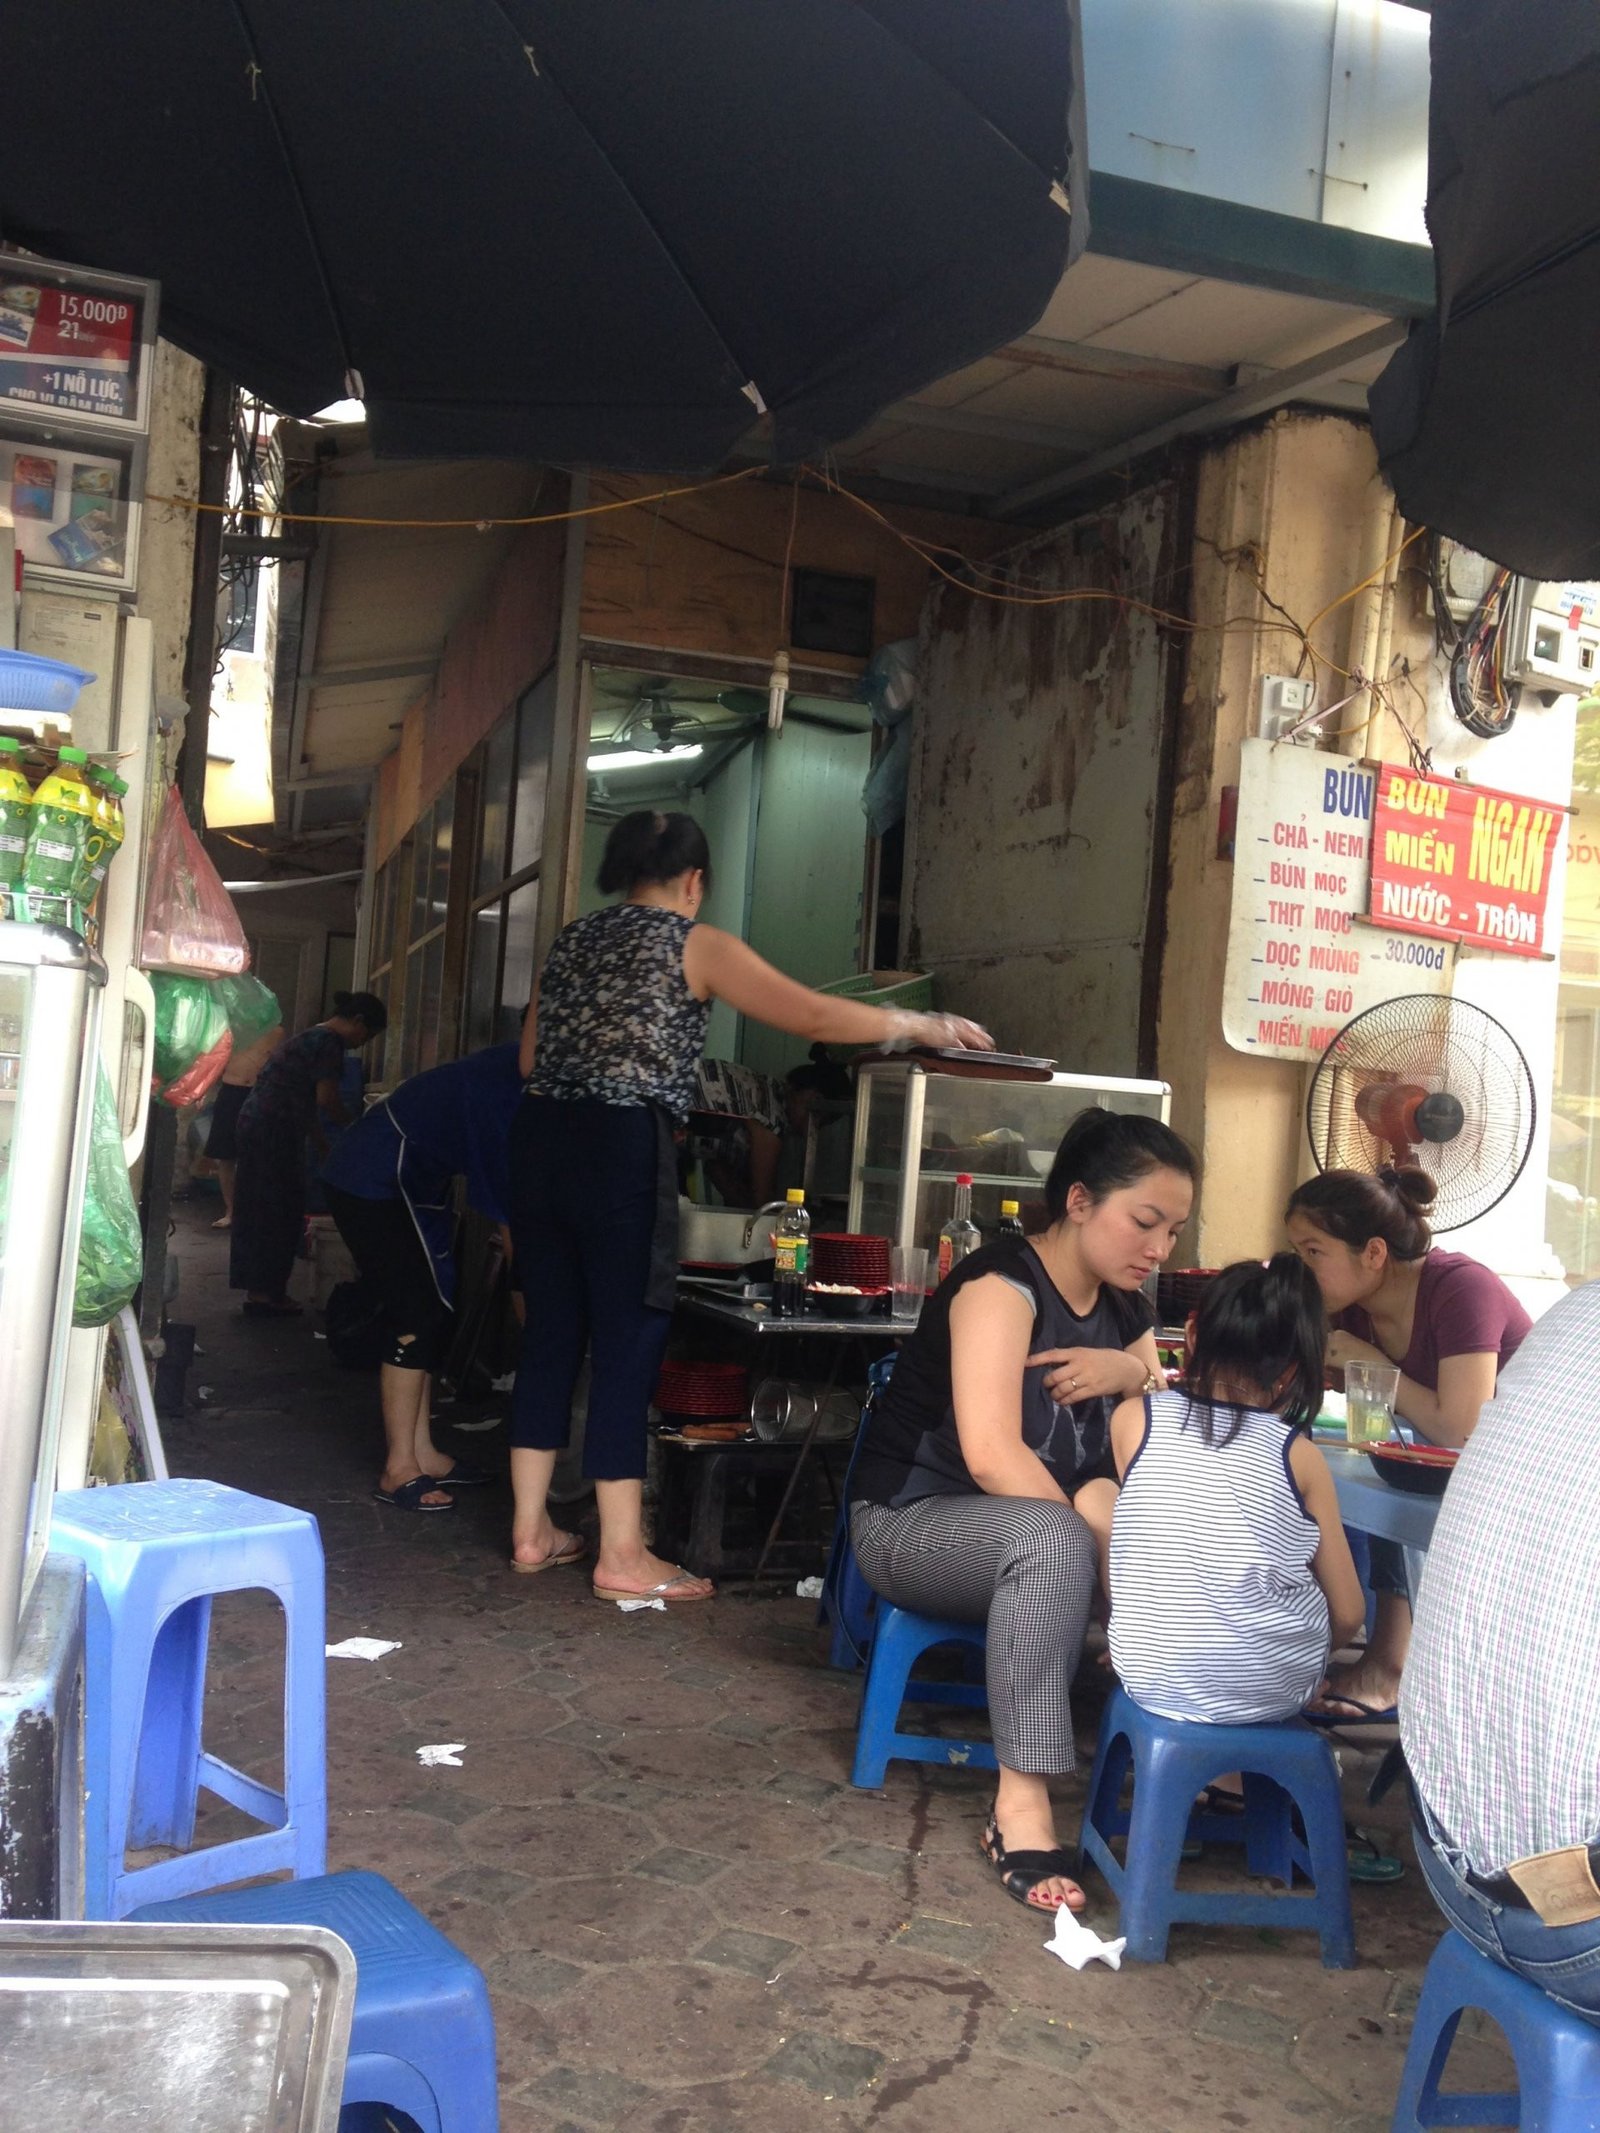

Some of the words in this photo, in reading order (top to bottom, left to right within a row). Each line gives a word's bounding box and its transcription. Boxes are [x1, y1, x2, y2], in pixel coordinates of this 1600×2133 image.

[57, 320, 80, 339] 21
[63, 370, 87, 395] NỖ
[1323, 762, 1372, 820] BÚN
[1273, 813, 1308, 849] CHẢ
[1324, 830, 1363, 859] NEM
[1385, 828, 1455, 877] MIẾN
[1468, 796, 1553, 895] NGAN
[1270, 857, 1306, 889] BÚN
[1314, 872, 1347, 897] MỌC
[1268, 900, 1305, 932] THỊT
[1314, 906, 1352, 938] MỌC
[1382, 881, 1452, 926] NƯỚC
[1475, 902, 1537, 946] TRỘN
[1265, 940, 1301, 971] DỌC
[1308, 942, 1360, 975] MÙNG
[1385, 938, 1445, 970] 30.000đ
[1261, 977, 1314, 1009] MÓNG
[1325, 985, 1353, 1013] GIÒ
[1258, 1014, 1302, 1047] MIẾN
